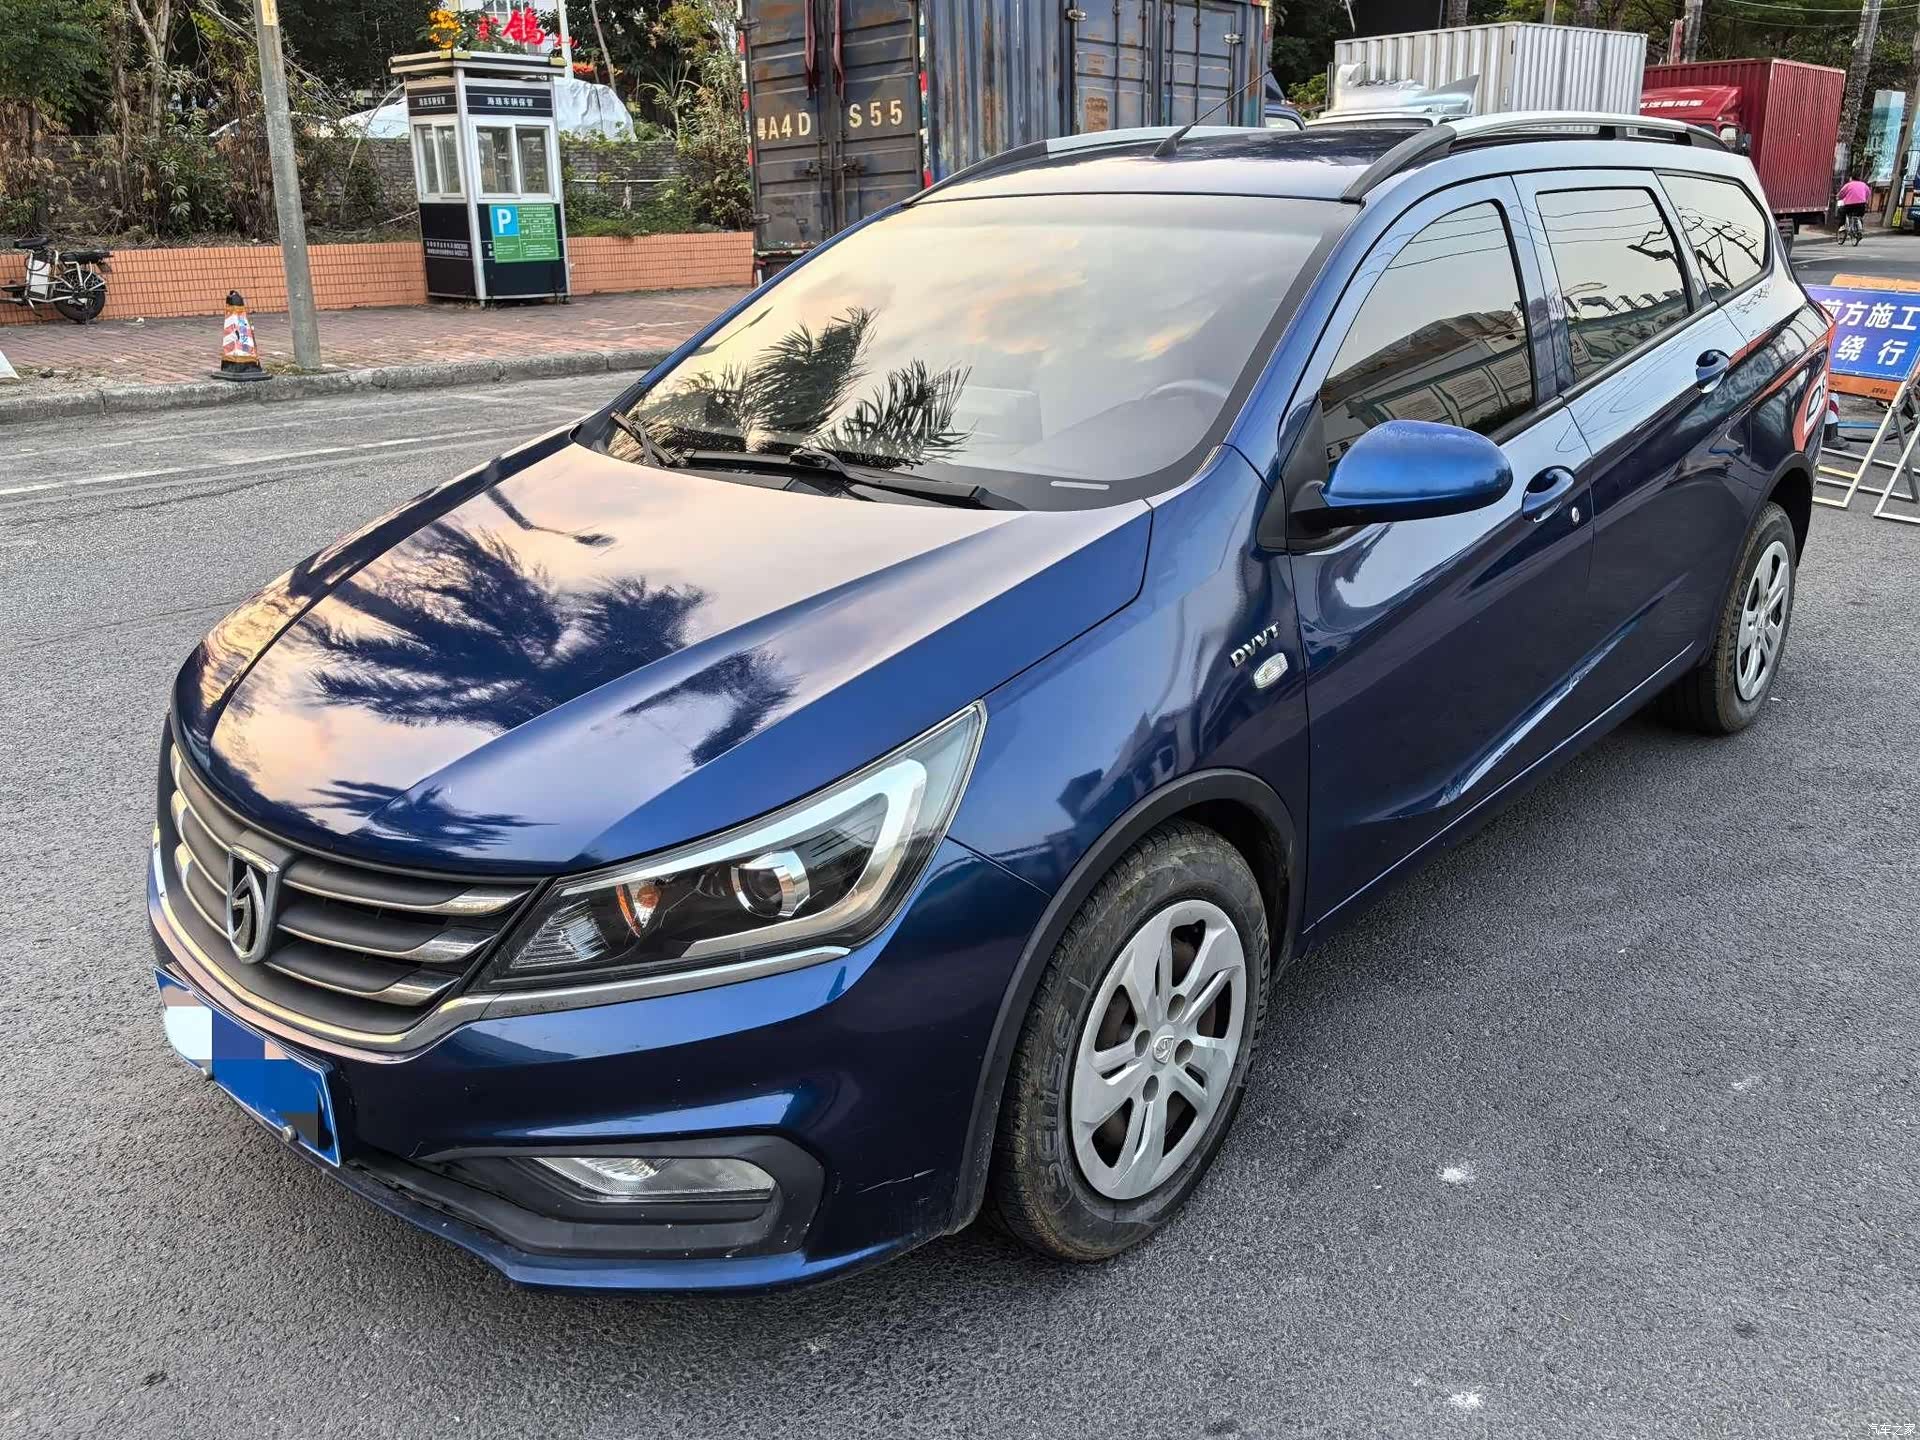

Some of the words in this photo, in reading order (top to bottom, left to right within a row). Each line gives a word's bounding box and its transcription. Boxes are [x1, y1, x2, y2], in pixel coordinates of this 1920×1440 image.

[848, 99, 903, 128] S55
[497, 208, 512, 234] P
[1834, 334, 1909, 367] 绕行
[1230, 622, 1279, 668] DVVT
